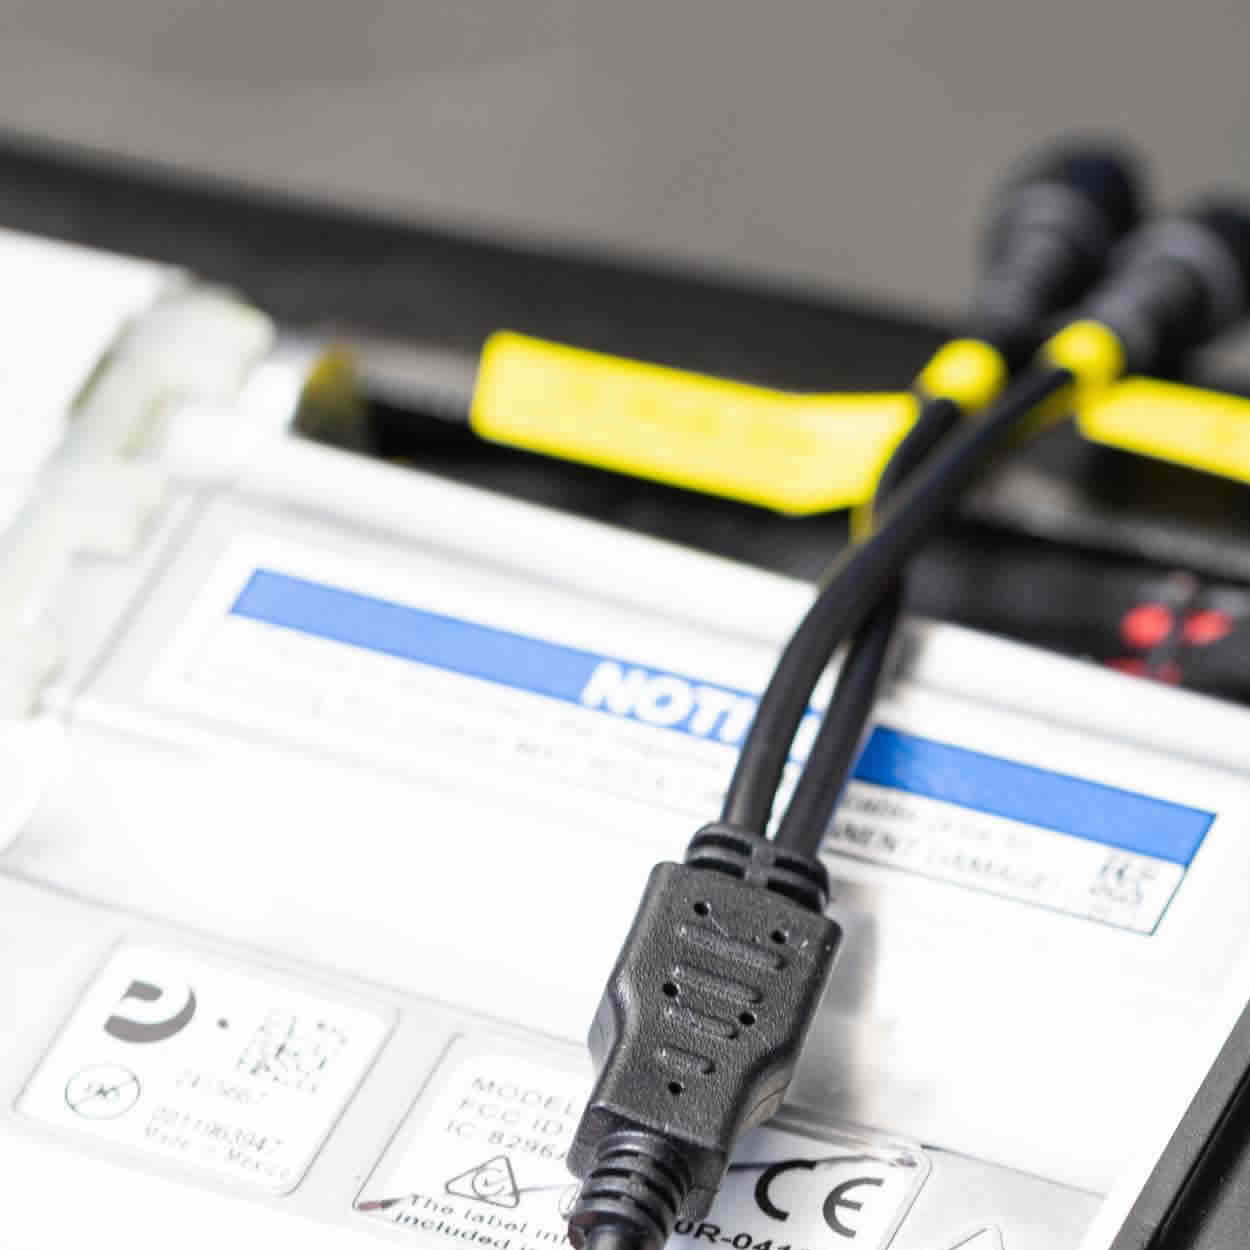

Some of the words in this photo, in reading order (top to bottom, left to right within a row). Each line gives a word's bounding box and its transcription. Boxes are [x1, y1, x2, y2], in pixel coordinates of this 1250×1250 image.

[579, 659, 759, 745] NOTI
[395, 1212, 511, 1250] included
[409, 1193, 454, 1216] The
[463, 1208, 528, 1233] label
